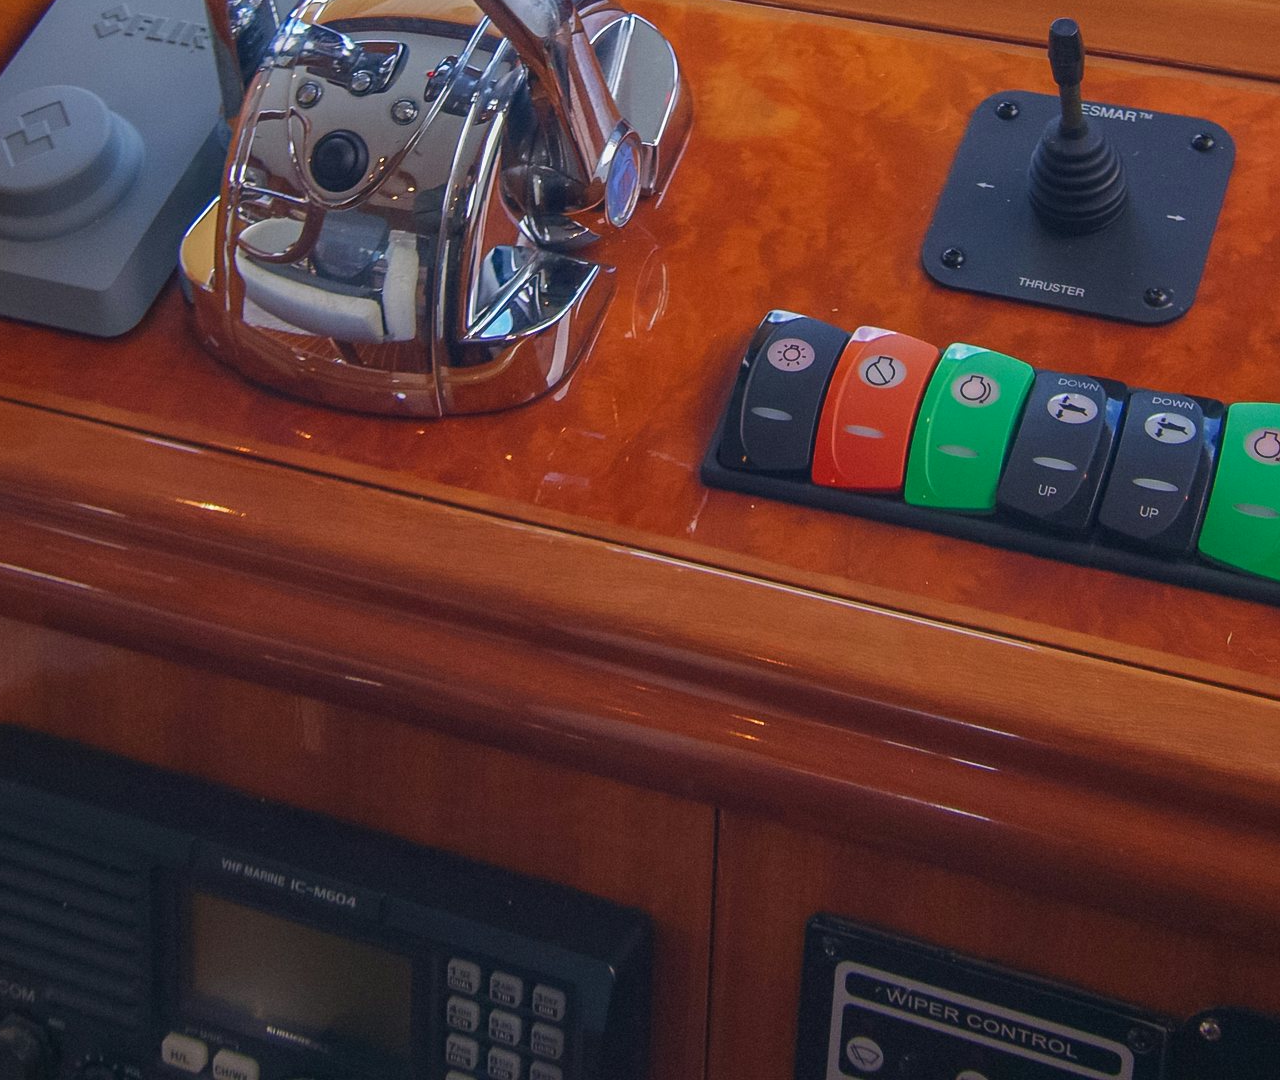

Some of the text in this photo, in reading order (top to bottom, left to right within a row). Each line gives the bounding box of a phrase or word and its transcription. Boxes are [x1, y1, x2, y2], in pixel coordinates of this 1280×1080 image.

[124, 12, 208, 50] FLIR
[1080, 102, 1138, 123] ESMAR
[1019, 276, 1086, 298] THRUSTER
[1057, 377, 1100, 392] DOWN
[1151, 395, 1195, 411] DOWN
[1037, 483, 1057, 498] UP
[1139, 505, 1160, 519] UP
[221, 857, 357, 909] VHF MARINE IC-M604
[886, 986, 1079, 1060] WIPER CONTROL
